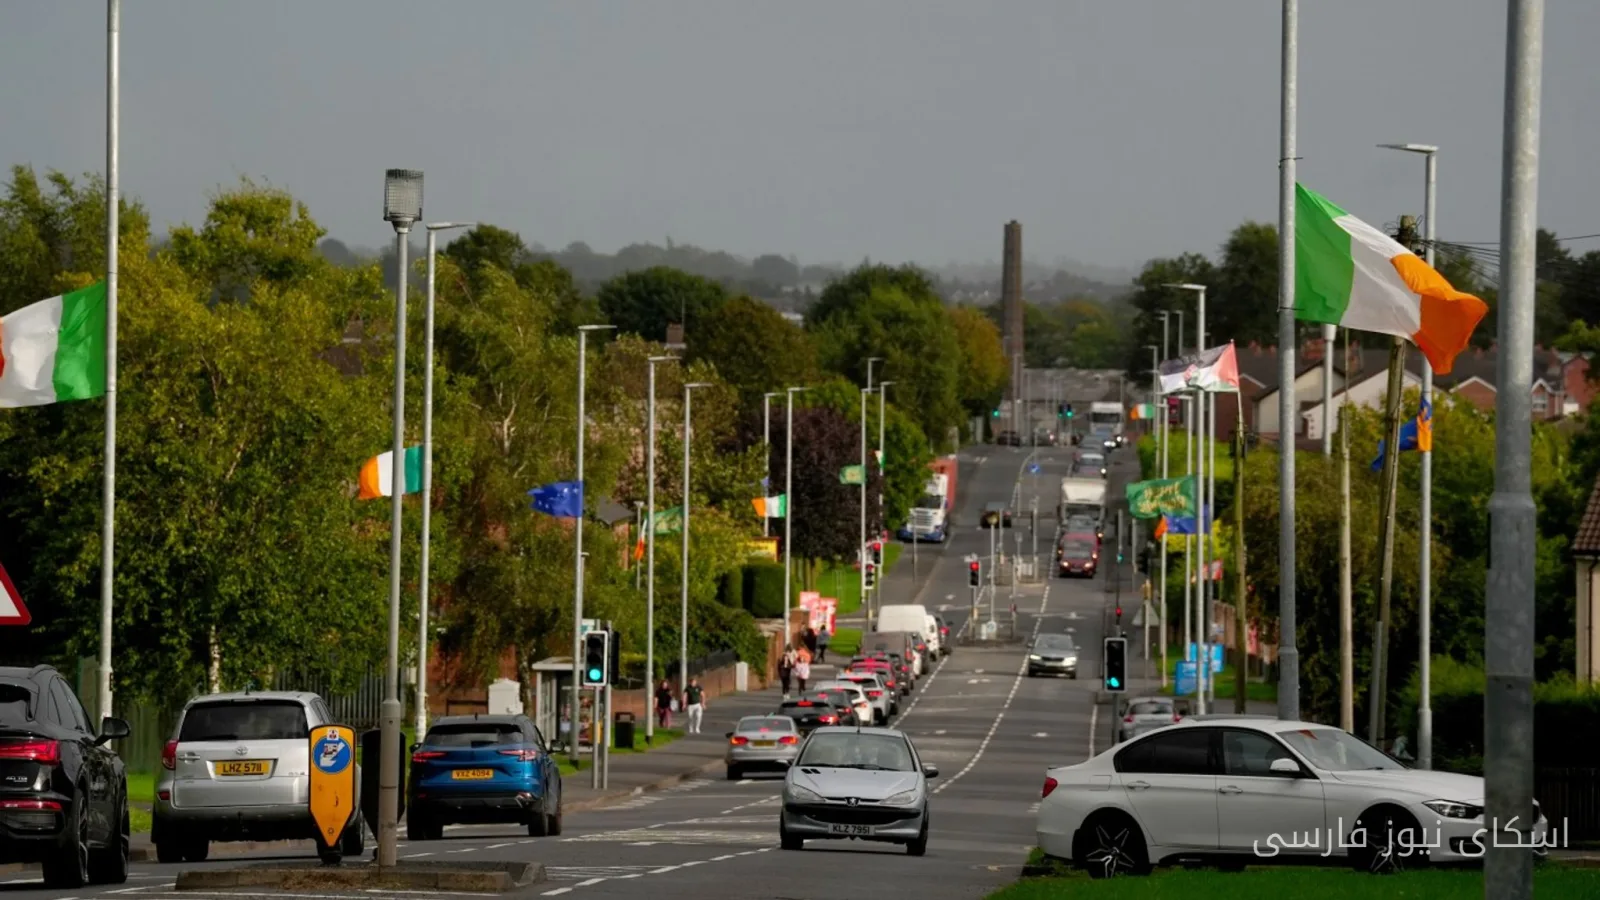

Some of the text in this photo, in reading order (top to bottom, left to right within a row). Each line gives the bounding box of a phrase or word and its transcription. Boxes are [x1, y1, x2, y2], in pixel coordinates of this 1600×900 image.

[223, 763, 242, 773] LHZ
[832, 824, 870, 835] KLZ 7951
